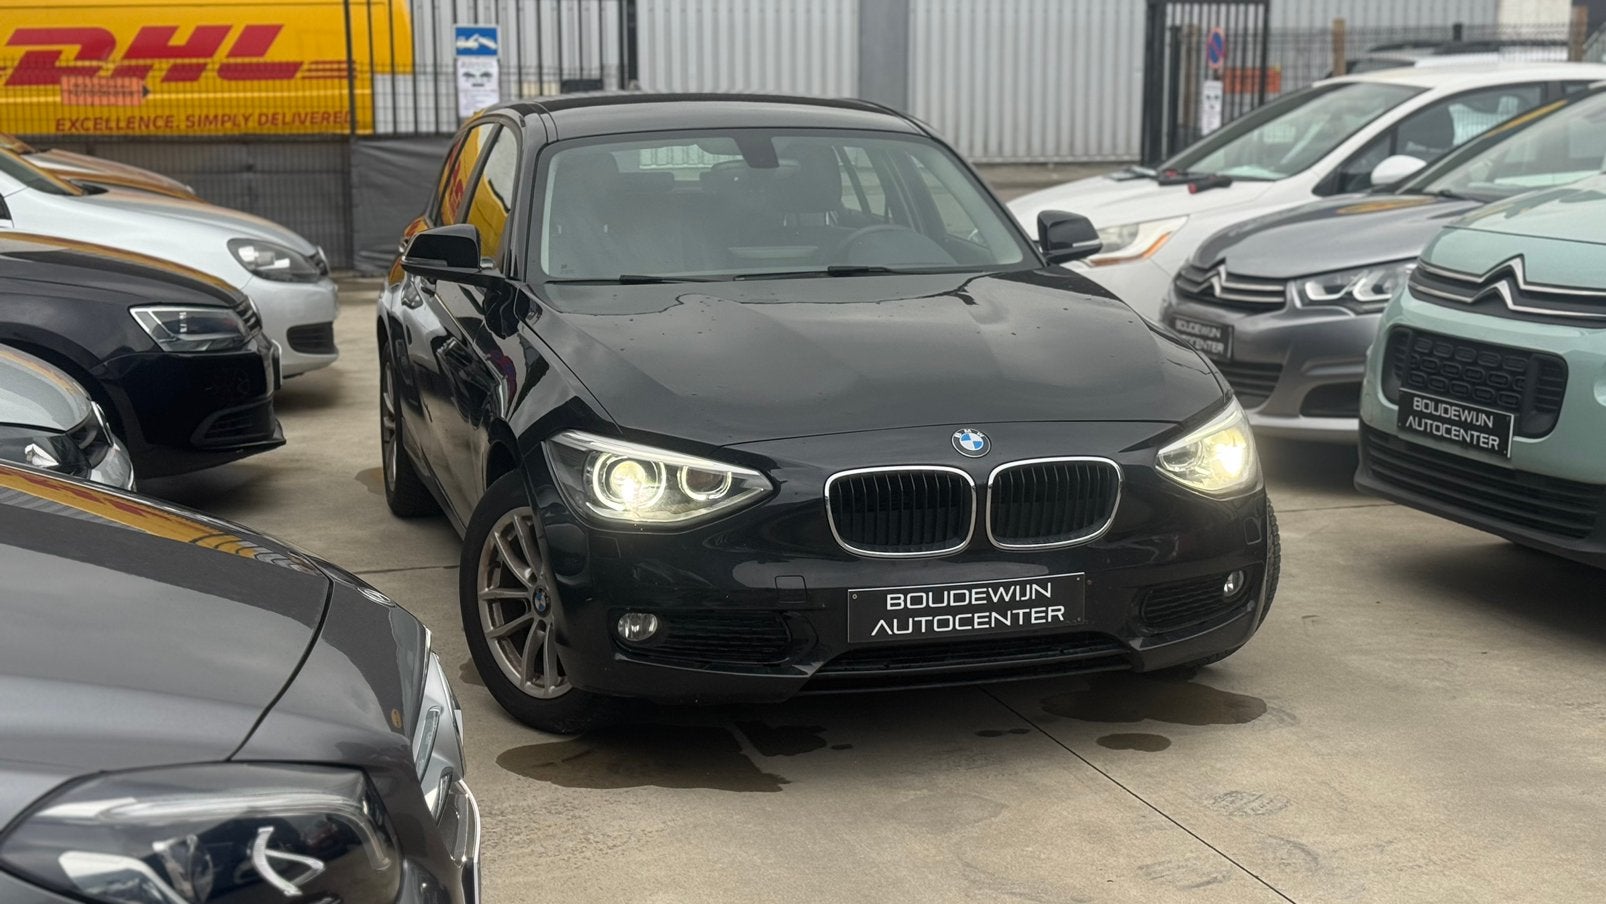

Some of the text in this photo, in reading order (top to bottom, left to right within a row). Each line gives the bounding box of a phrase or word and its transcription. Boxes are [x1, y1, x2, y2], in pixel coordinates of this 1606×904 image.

[4, 24, 305, 87] DHL
[185, 112, 253, 129] SIMPLY
[1413, 397, 1494, 429] BOUDEWIJN
[1405, 415, 1500, 451] AUTOCENTER
[886, 582, 1051, 610] BOUDEWIJN
[871, 605, 1065, 636] AUTOCENTER
